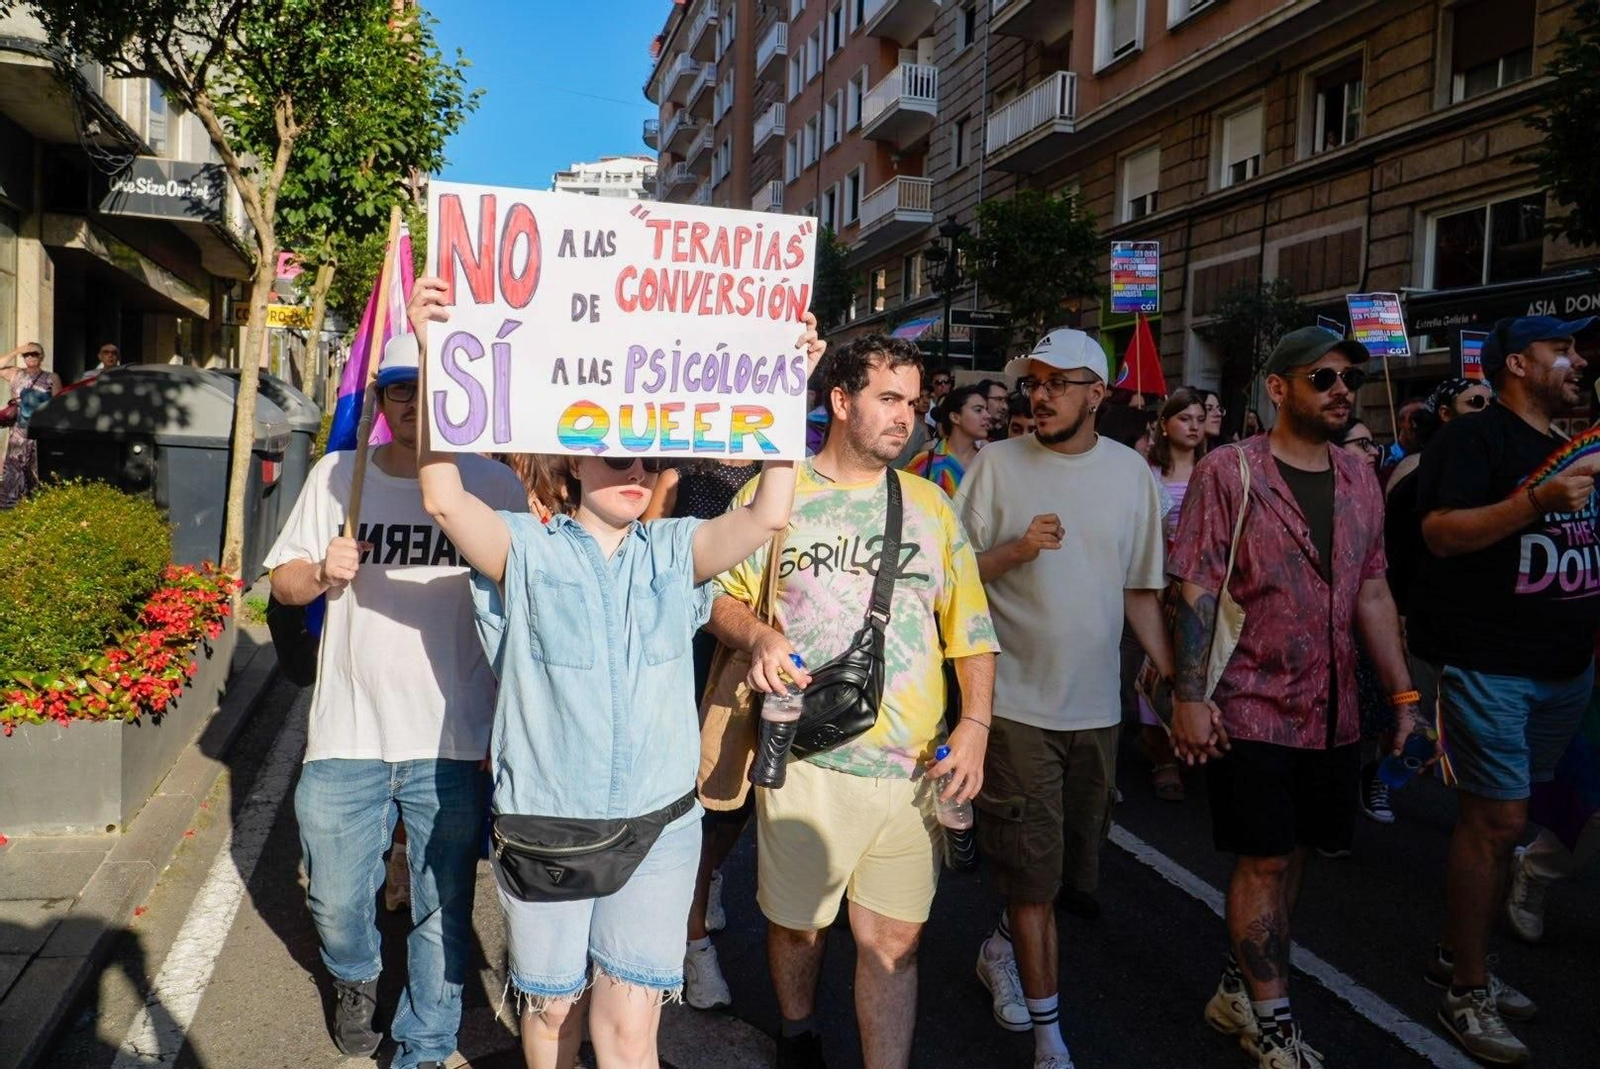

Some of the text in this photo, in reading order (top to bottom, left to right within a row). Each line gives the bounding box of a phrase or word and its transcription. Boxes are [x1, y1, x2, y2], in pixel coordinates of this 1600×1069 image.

[437, 193, 542, 309] NO
[558, 229, 578, 258] A
[584, 229, 617, 258] LAS
[571, 292, 601, 323] DE
[1140, 303, 1156, 311] CGT
[1527, 301, 1556, 317] ASIA
[433, 319, 522, 446] SÍ
[551, 357, 569, 385] A
[578, 357, 614, 386] LAS
[556, 400, 780, 456] QUEER
[1561, 521, 1594, 546] THE
